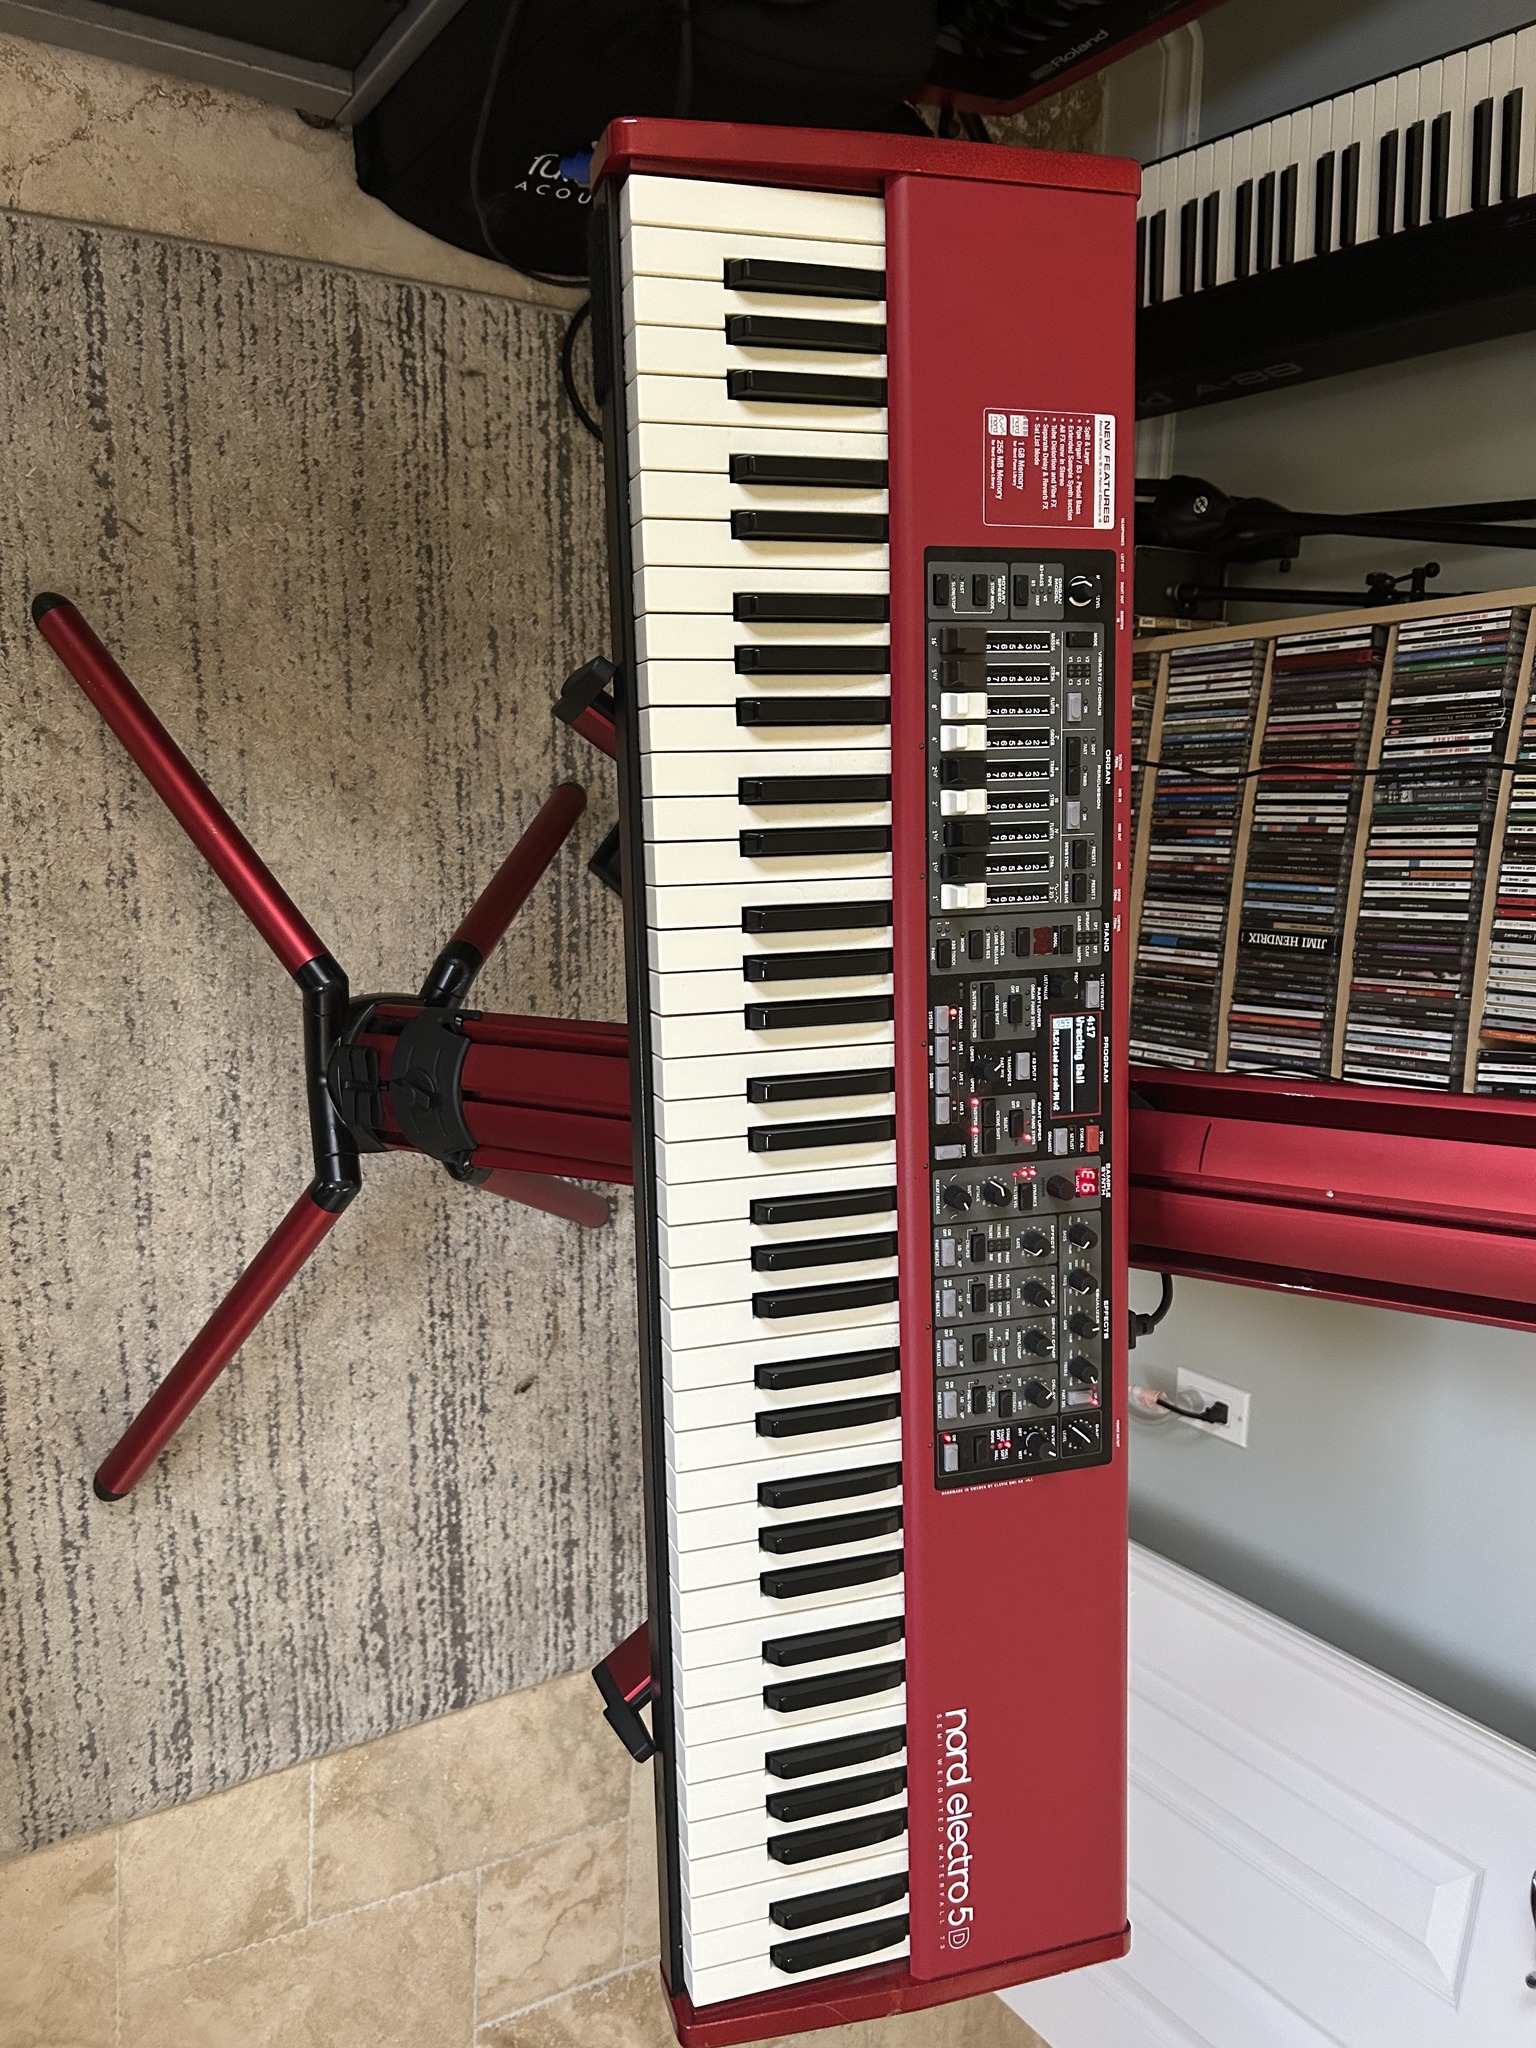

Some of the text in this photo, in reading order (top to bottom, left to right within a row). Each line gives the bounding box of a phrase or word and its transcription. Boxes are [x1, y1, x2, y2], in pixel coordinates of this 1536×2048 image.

[1050, 28, 1110, 68] Roland
[997, 456, 1003, 467] MB
[1019, 448, 1024, 458] GB
[1077, 465, 1082, 473] B3
[1248, 933, 1327, 949] JIMI HENDRIX
[1087, 1016, 1095, 1038] 4:17
[1074, 1016, 1084, 1083] Wrecking Ball
[946, 1708, 971, 1786] nord
[947, 1793, 972, 1903] electro
[940, 1936, 945, 1949] 73
